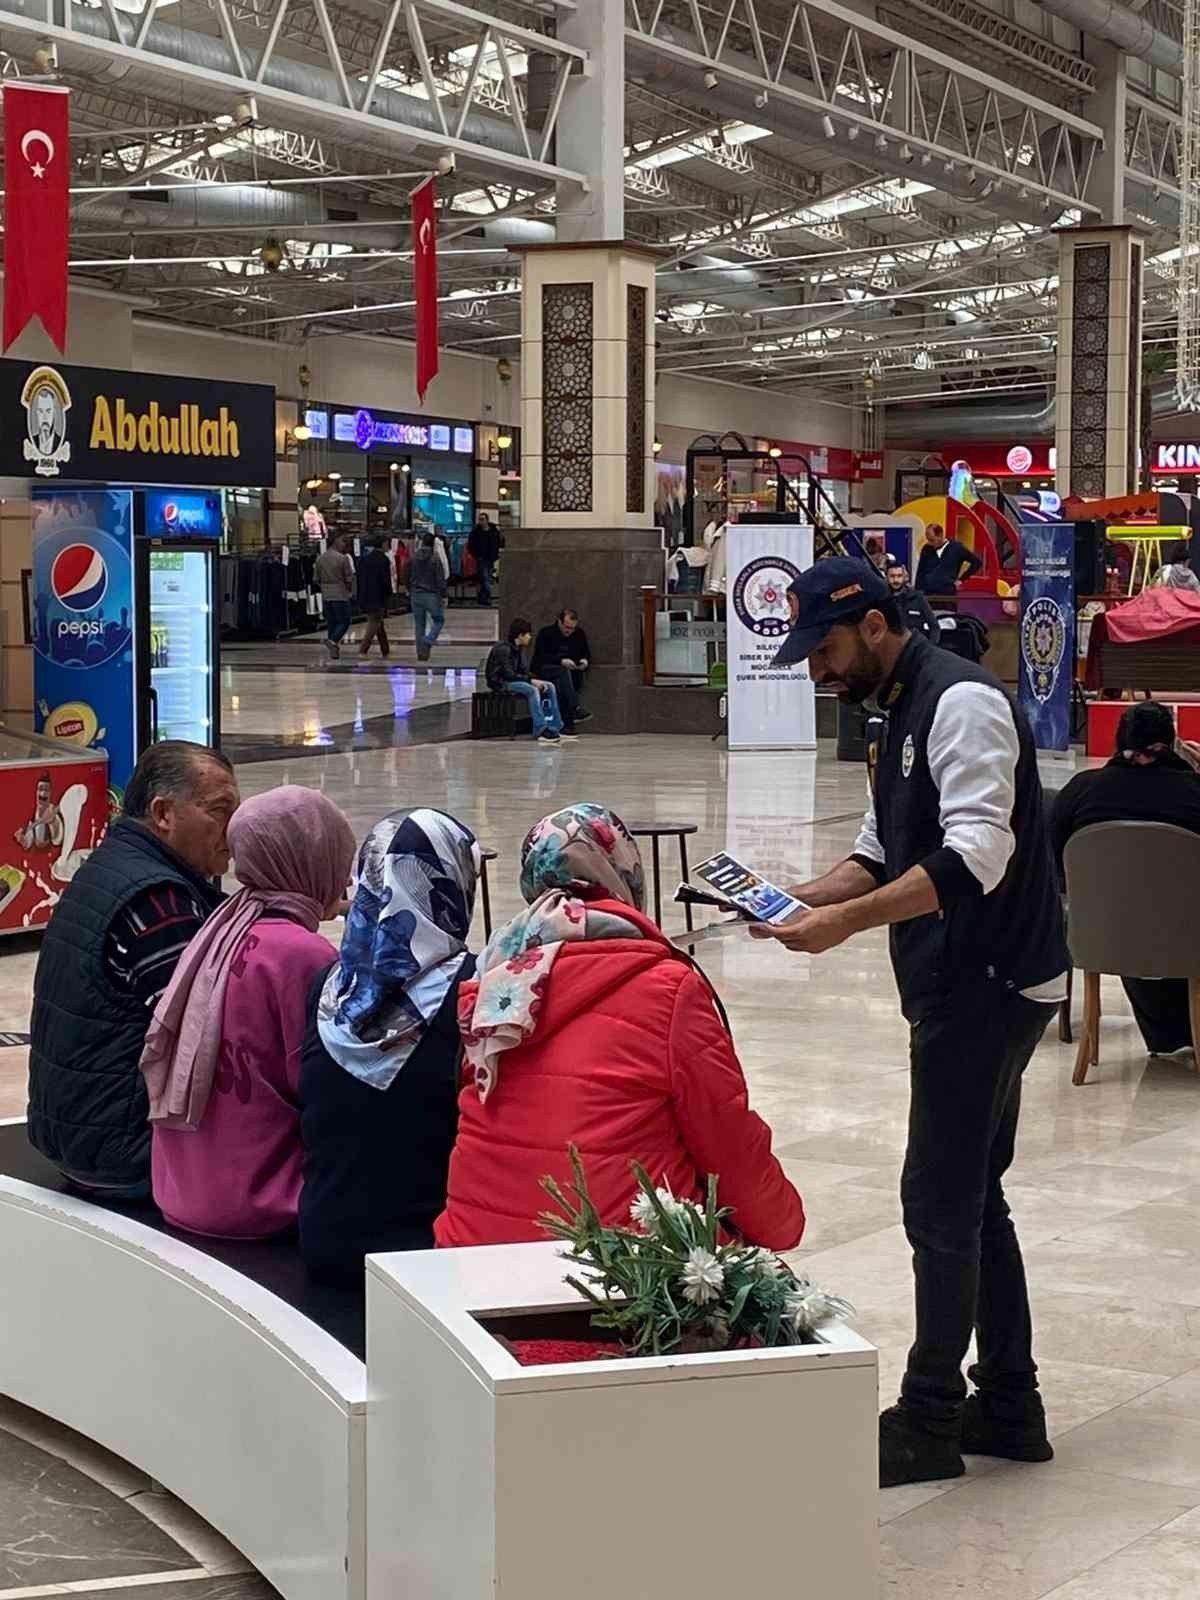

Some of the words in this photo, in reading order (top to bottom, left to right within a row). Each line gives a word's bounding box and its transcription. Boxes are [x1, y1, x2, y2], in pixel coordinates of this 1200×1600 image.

[90, 395, 240, 458] Abdullah
[58, 619, 104, 638] pepsi
[57, 723, 83, 736] Lipton
